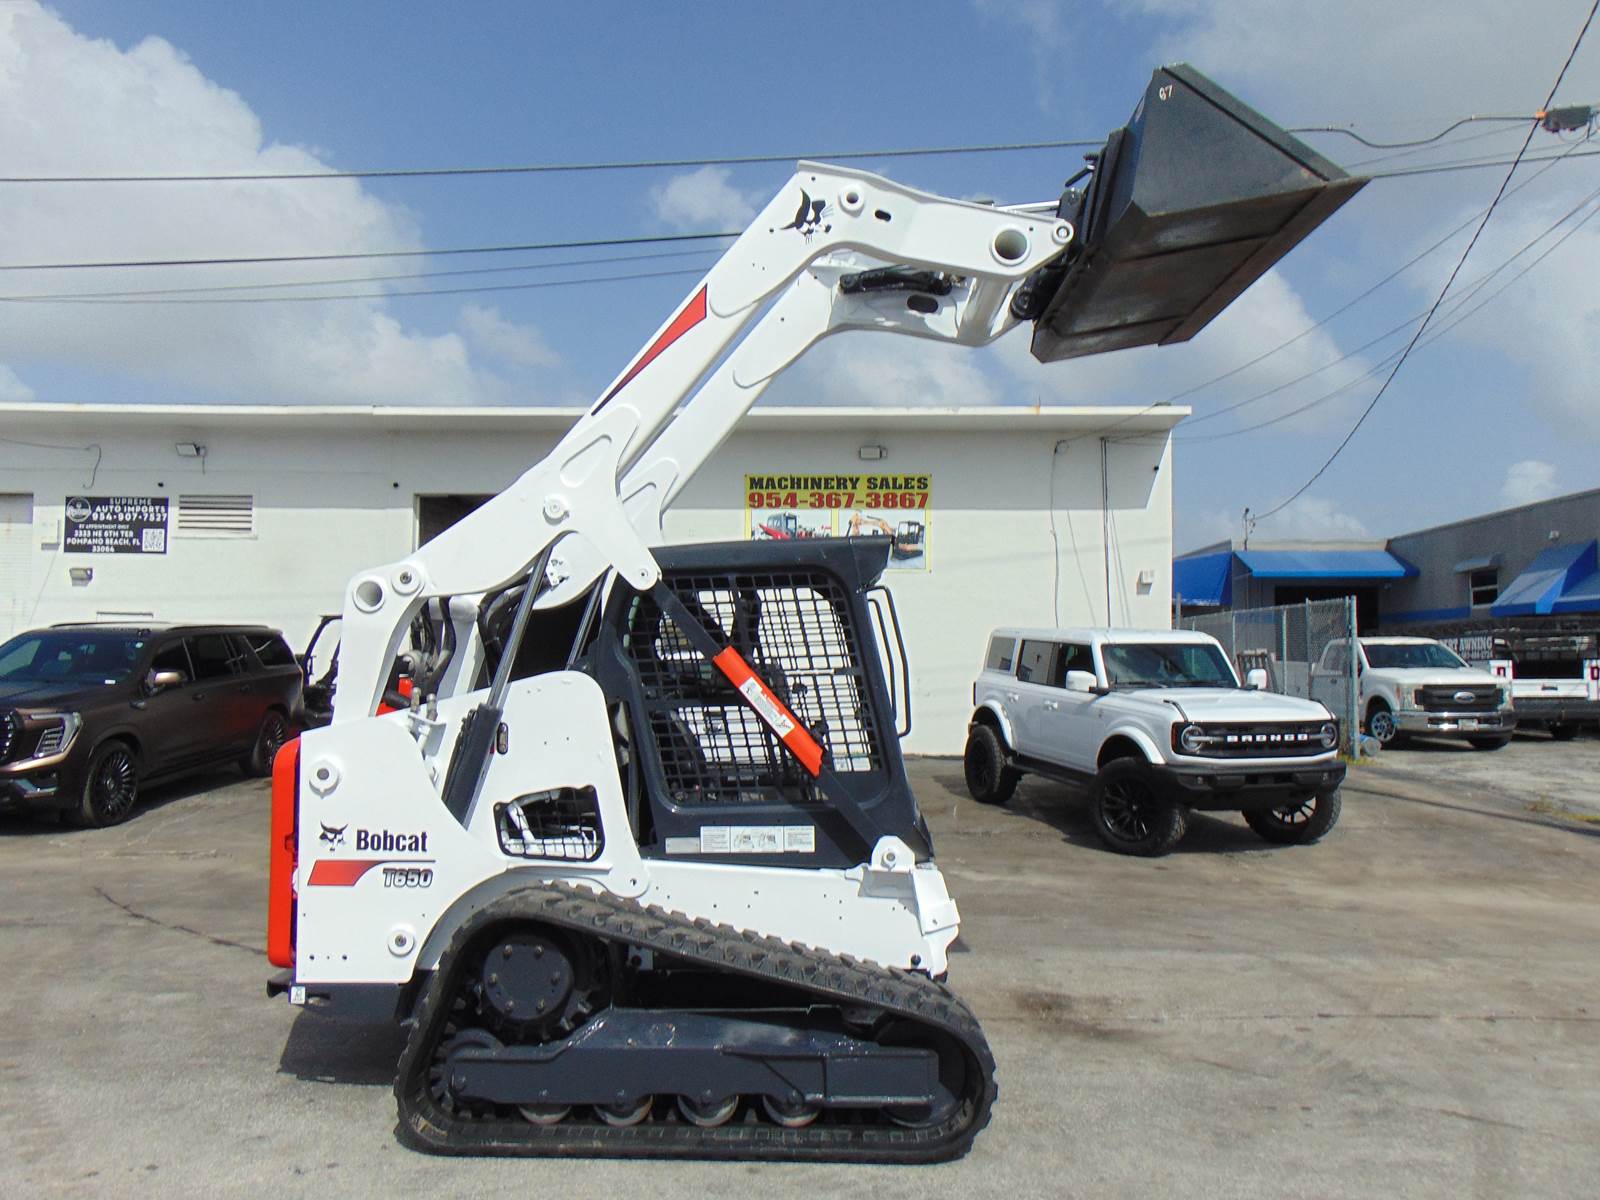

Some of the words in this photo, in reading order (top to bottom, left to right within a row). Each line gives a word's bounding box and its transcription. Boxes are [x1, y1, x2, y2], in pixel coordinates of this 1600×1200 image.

[749, 476, 860, 490] MACHINERY
[866, 476, 929, 490] SALES
[109, 497, 152, 506] SUPREME
[748, 492, 929, 509] 954-367-3867
[95, 505, 122, 513] AUTO
[123, 505, 166, 513] IMPORTS
[66, 537, 104, 545] POMPANO
[105, 538, 131, 546] BEACH,
[132, 538, 141, 546] FL
[1226, 733, 1309, 743] BRONCO
[356, 829, 428, 852] Bobcat
[382, 868, 434, 888] T650
